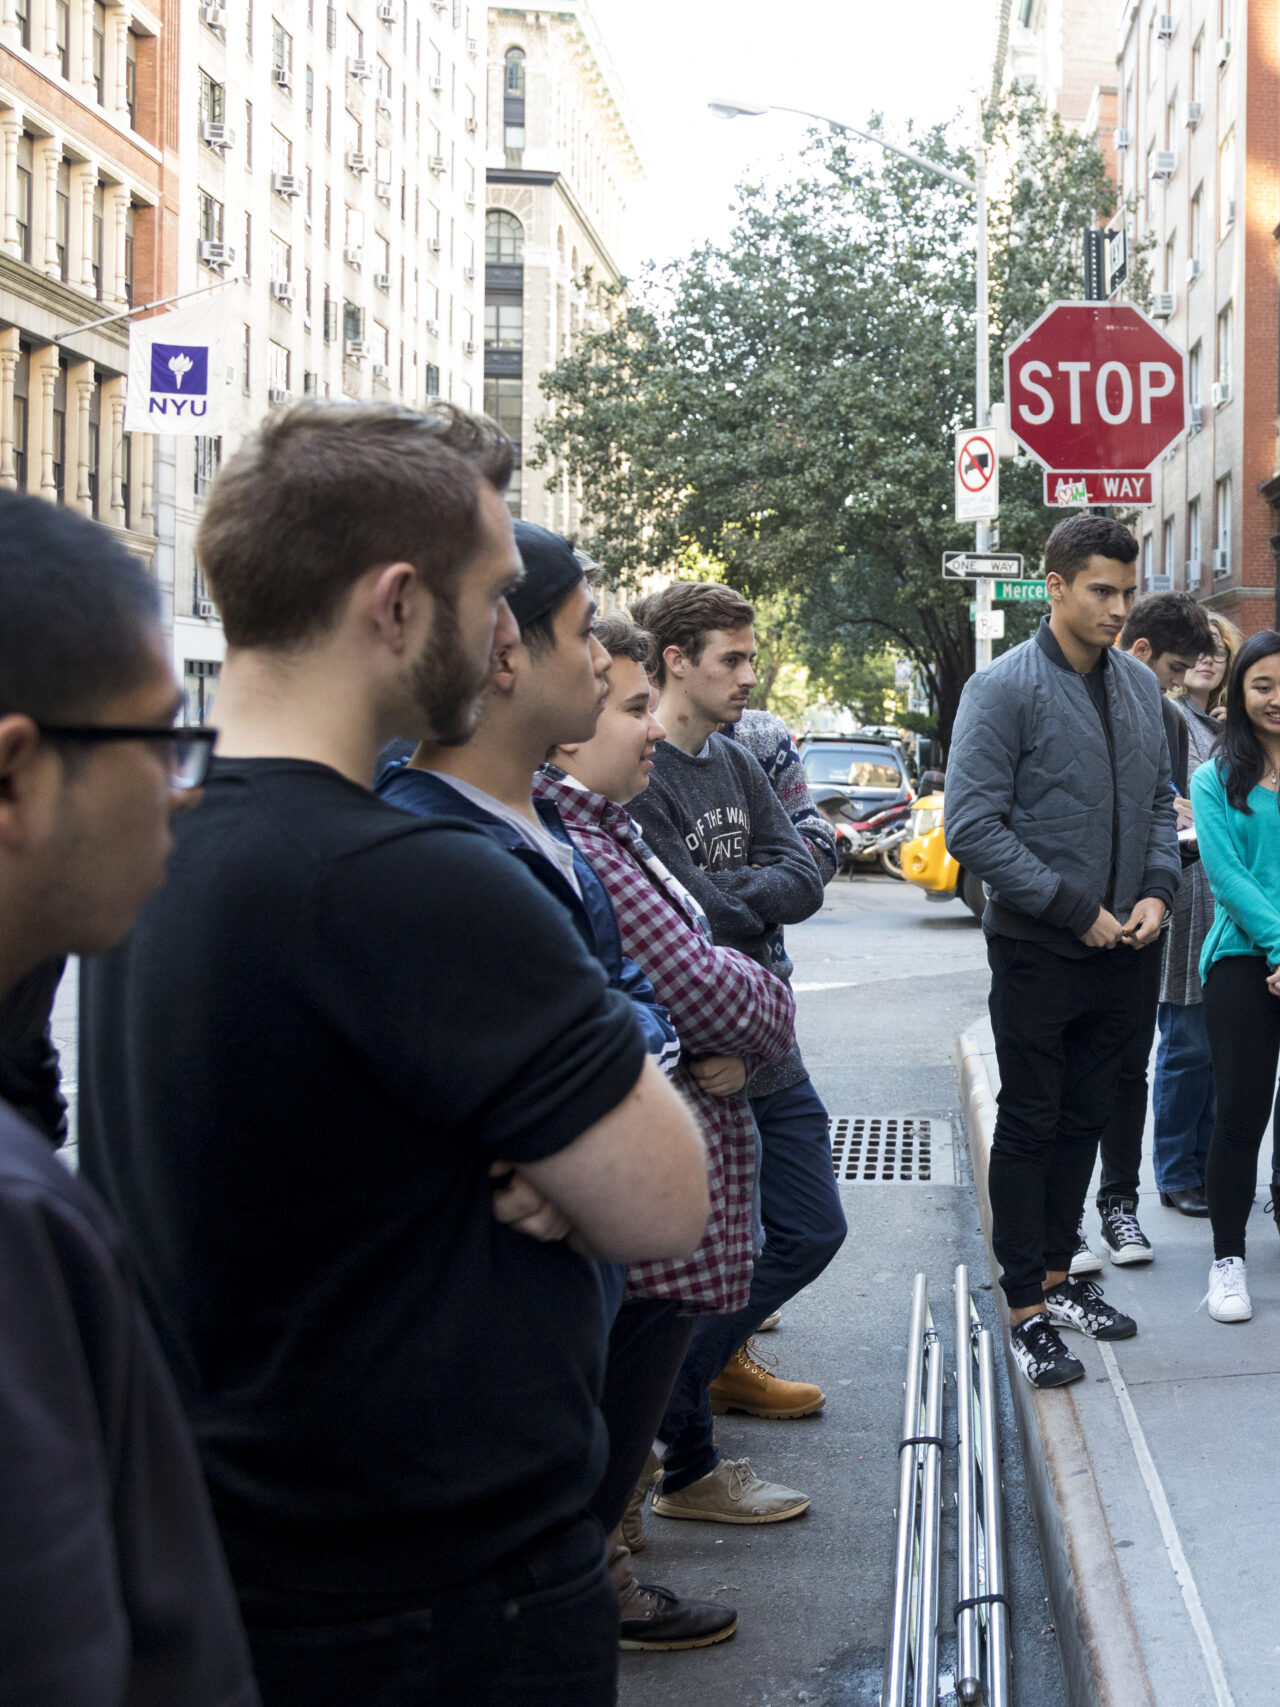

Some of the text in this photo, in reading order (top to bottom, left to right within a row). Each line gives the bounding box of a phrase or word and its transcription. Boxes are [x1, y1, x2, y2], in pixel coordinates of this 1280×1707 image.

[1018, 360, 1176, 425] STOP
[149, 397, 207, 417] NYU
[1103, 477, 1145, 497] WAY
[952, 560, 1016, 571] ONE WAY
[704, 808, 723, 829] THE
